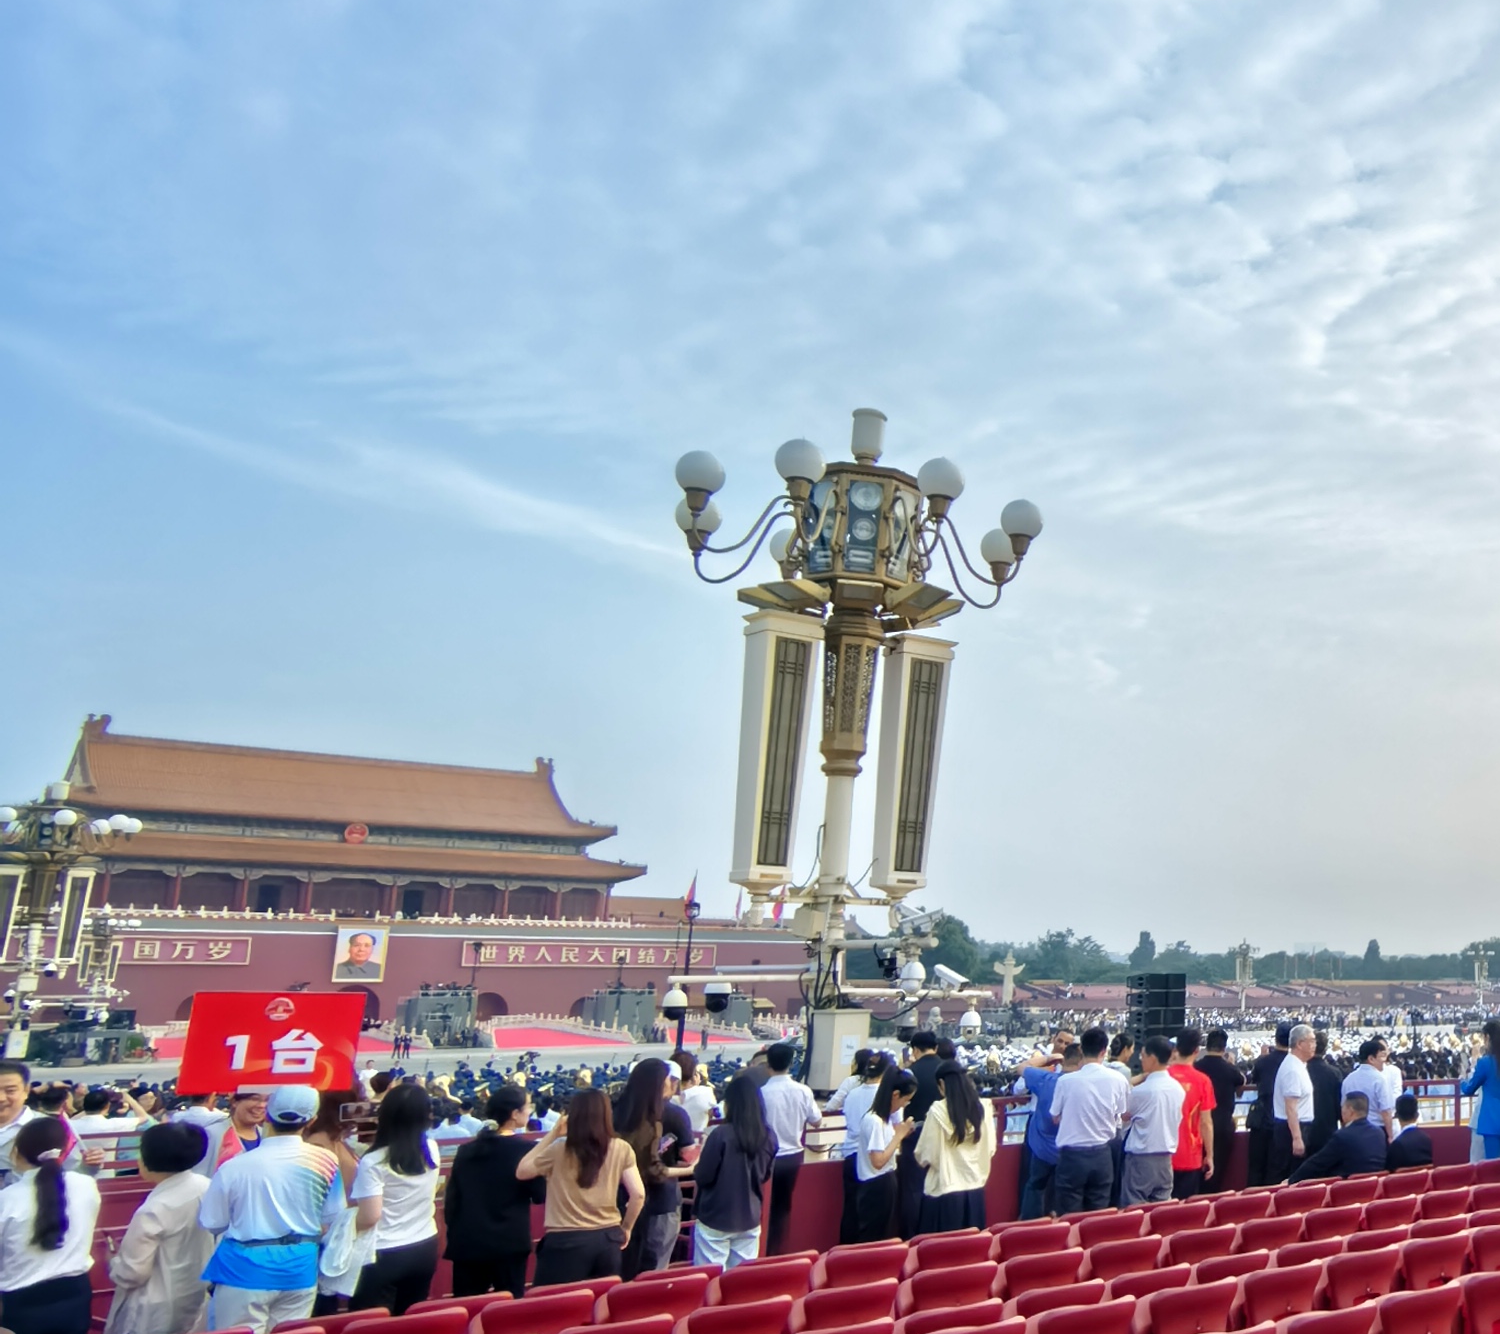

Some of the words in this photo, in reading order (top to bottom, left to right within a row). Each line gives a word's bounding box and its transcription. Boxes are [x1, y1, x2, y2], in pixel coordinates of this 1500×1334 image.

[479, 944, 705, 965] 世界人民大团结万岁
